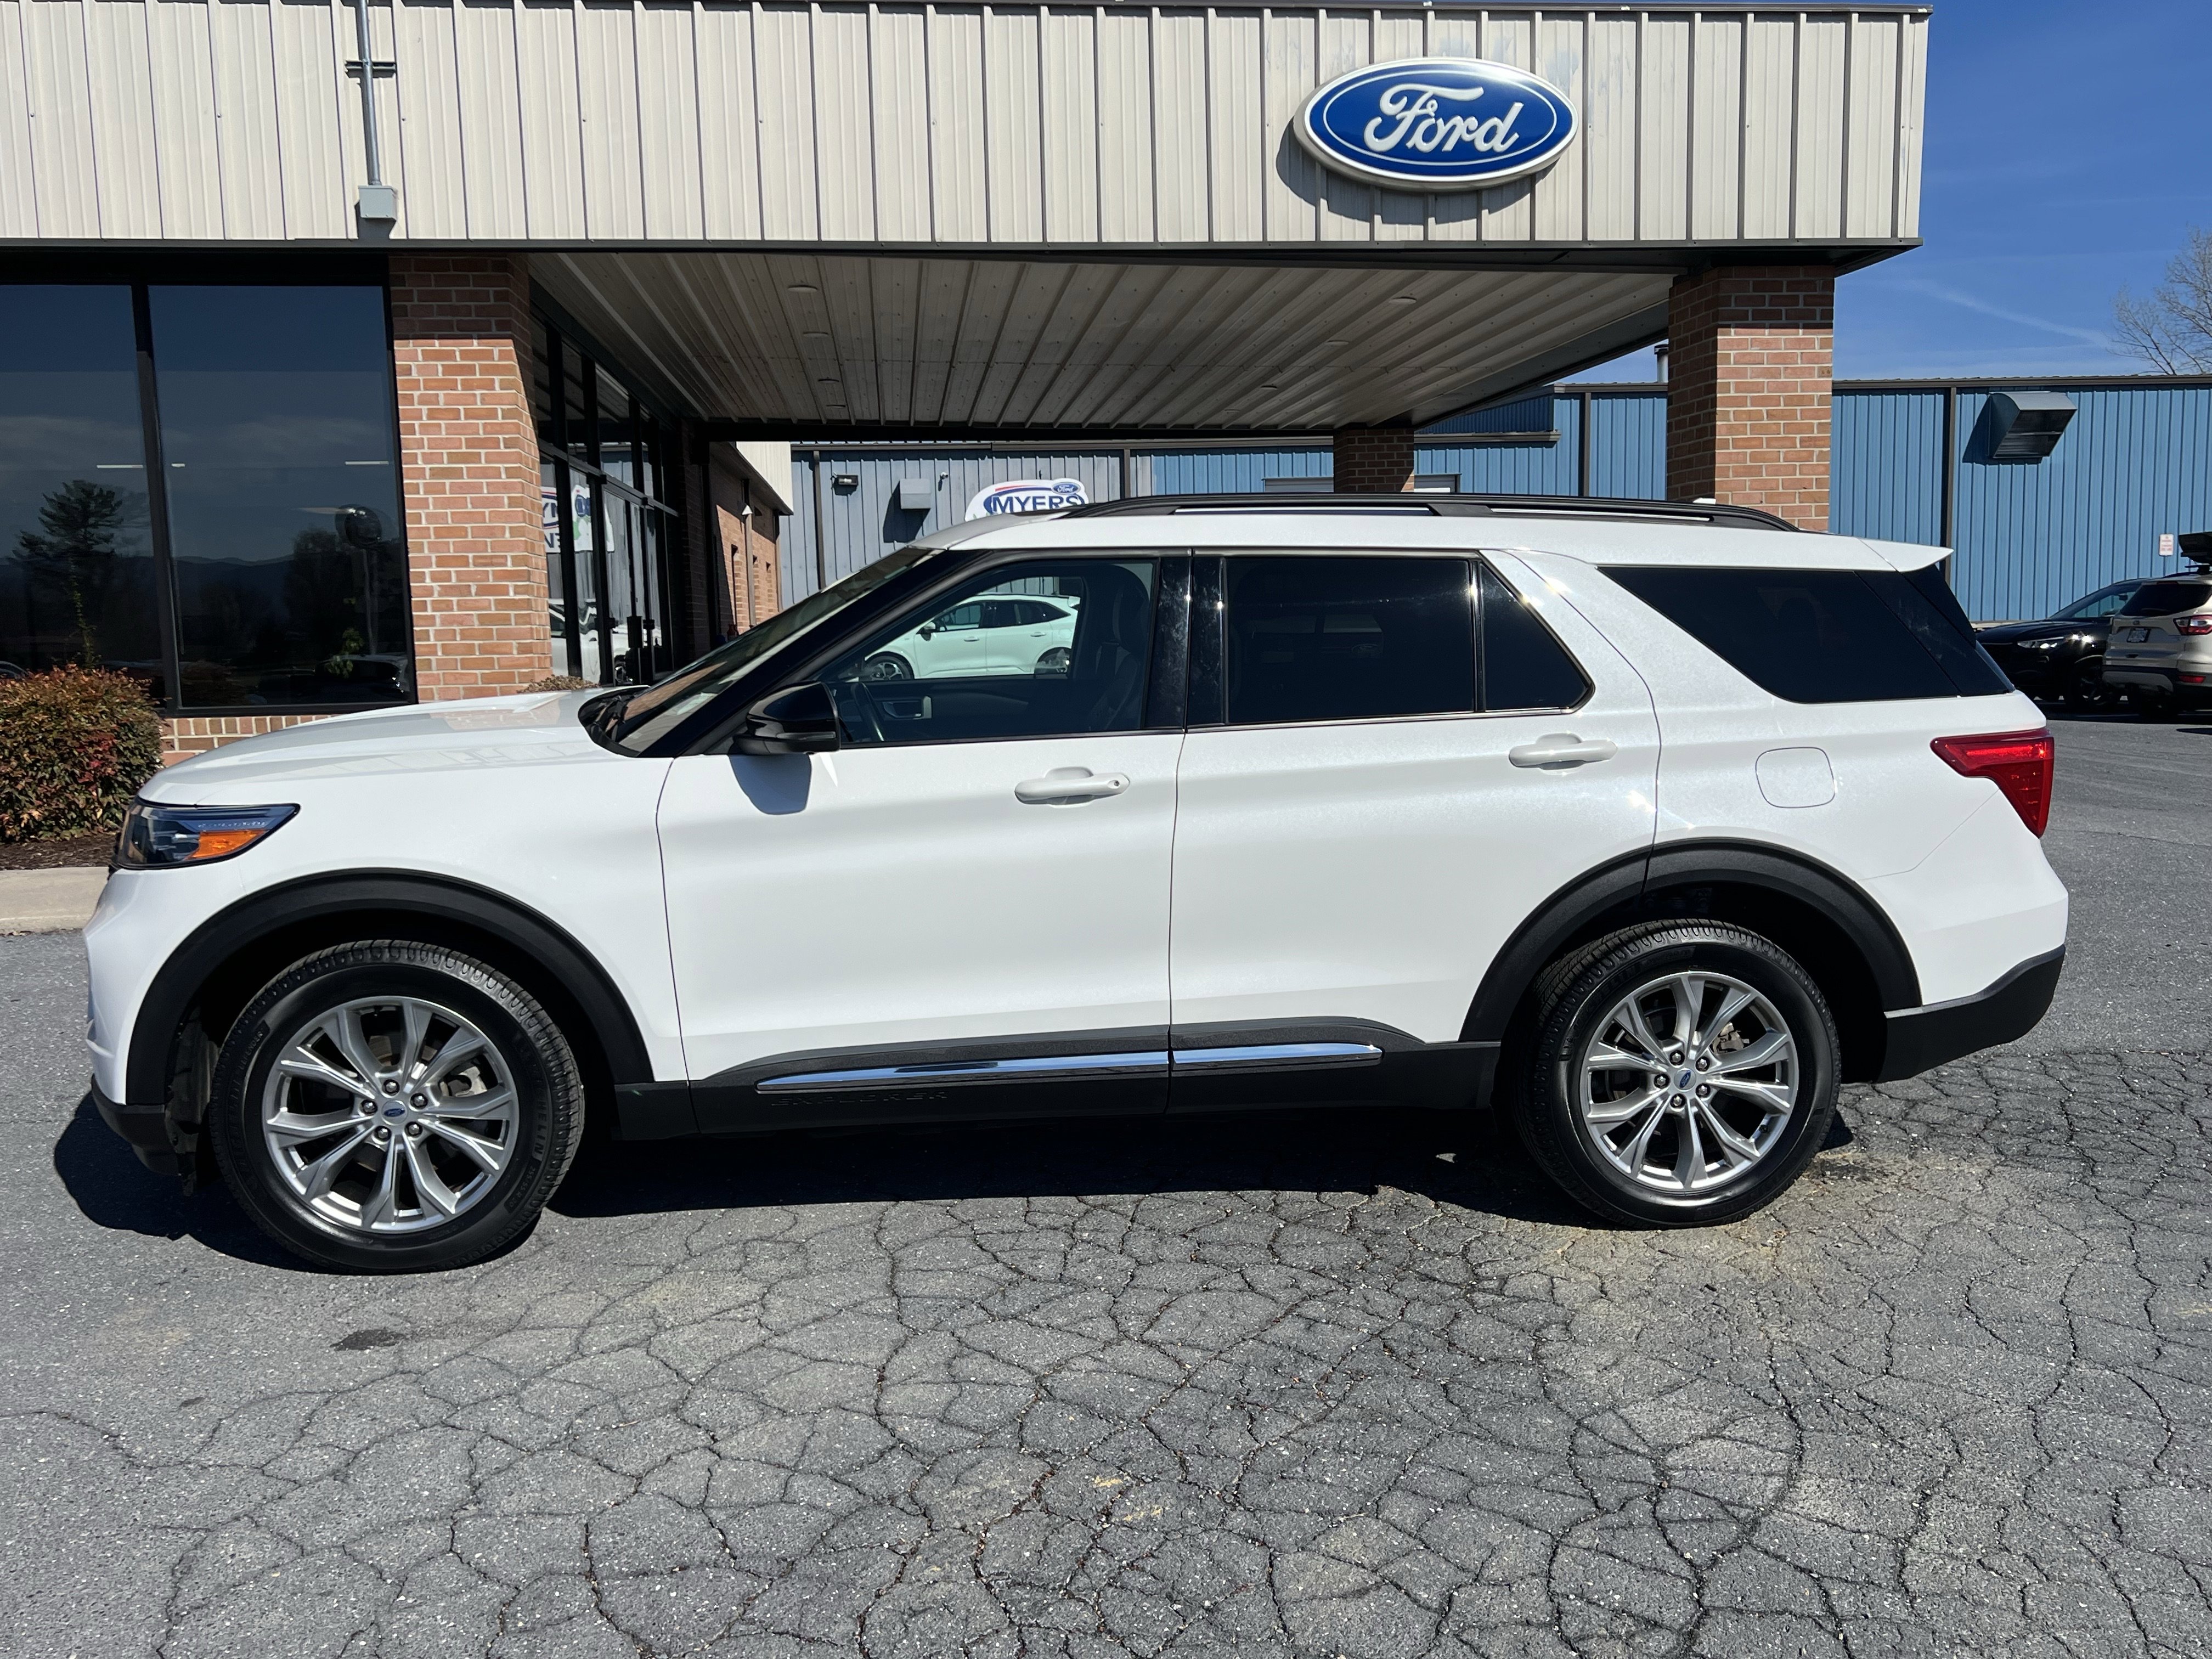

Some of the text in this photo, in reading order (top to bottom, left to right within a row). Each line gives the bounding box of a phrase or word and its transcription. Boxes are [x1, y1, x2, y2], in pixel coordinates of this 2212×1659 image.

[1364, 83, 1524, 153] Ford
[1057, 484, 1074, 493] Ford
[992, 495, 1078, 514] MYERS
